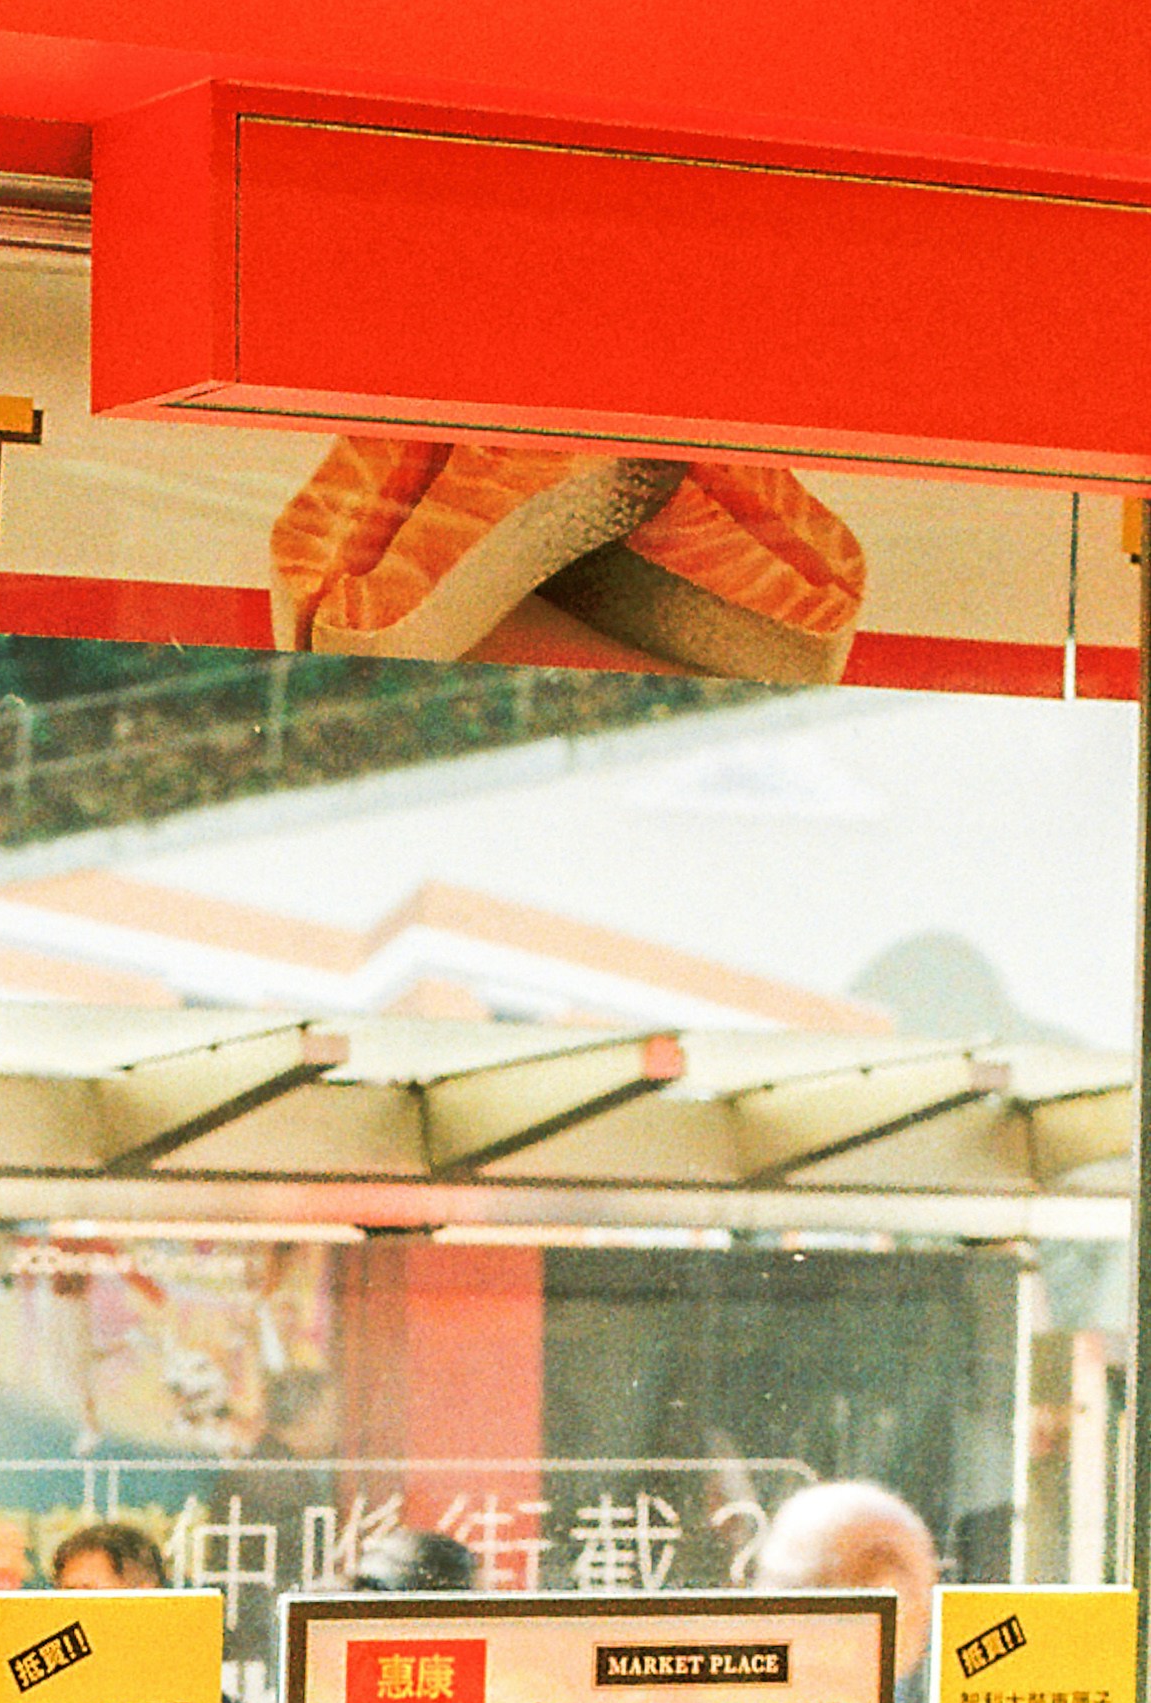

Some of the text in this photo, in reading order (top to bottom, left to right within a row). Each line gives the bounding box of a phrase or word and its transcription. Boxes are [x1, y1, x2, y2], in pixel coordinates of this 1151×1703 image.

[377, 1654, 454, 1698] 惠康
[607, 1653, 780, 1678] MARKET PLACE
